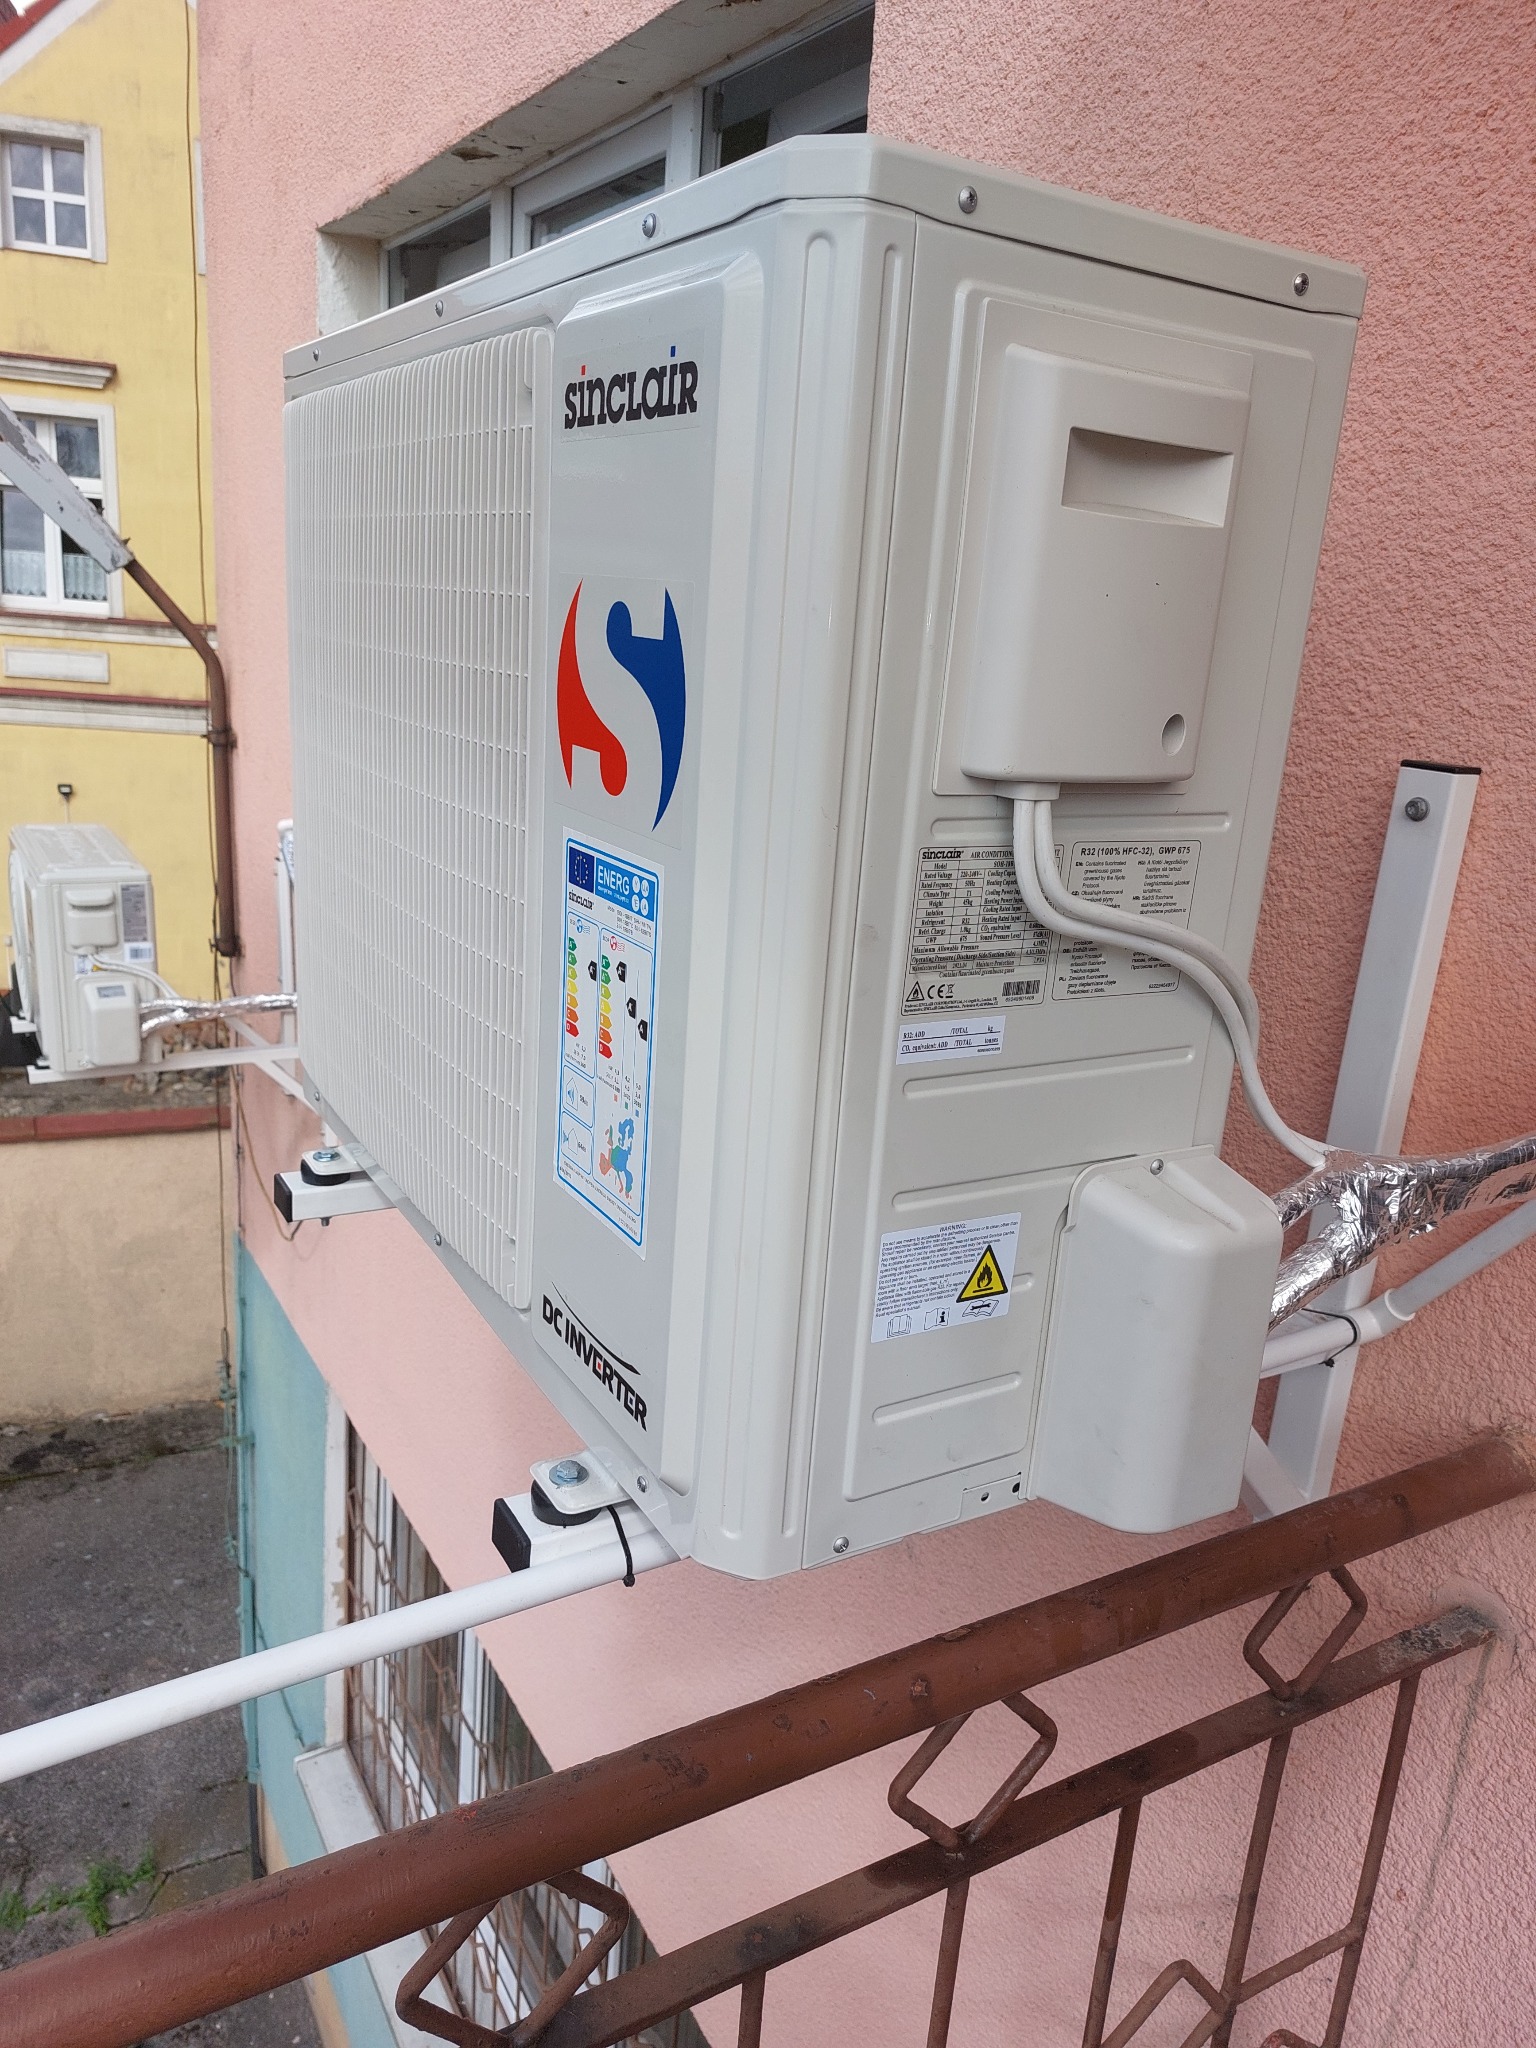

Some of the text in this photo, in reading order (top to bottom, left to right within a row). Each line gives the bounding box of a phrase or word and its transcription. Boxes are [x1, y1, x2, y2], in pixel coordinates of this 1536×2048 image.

[1081, 848, 1095, 856] R32
[1098, 848, 1120, 857] (100%
[1122, 847, 1154, 857] HFC-32),
[598, 865, 630, 895] ENERG
[543, 1294, 647, 1432] DC INVERTER
